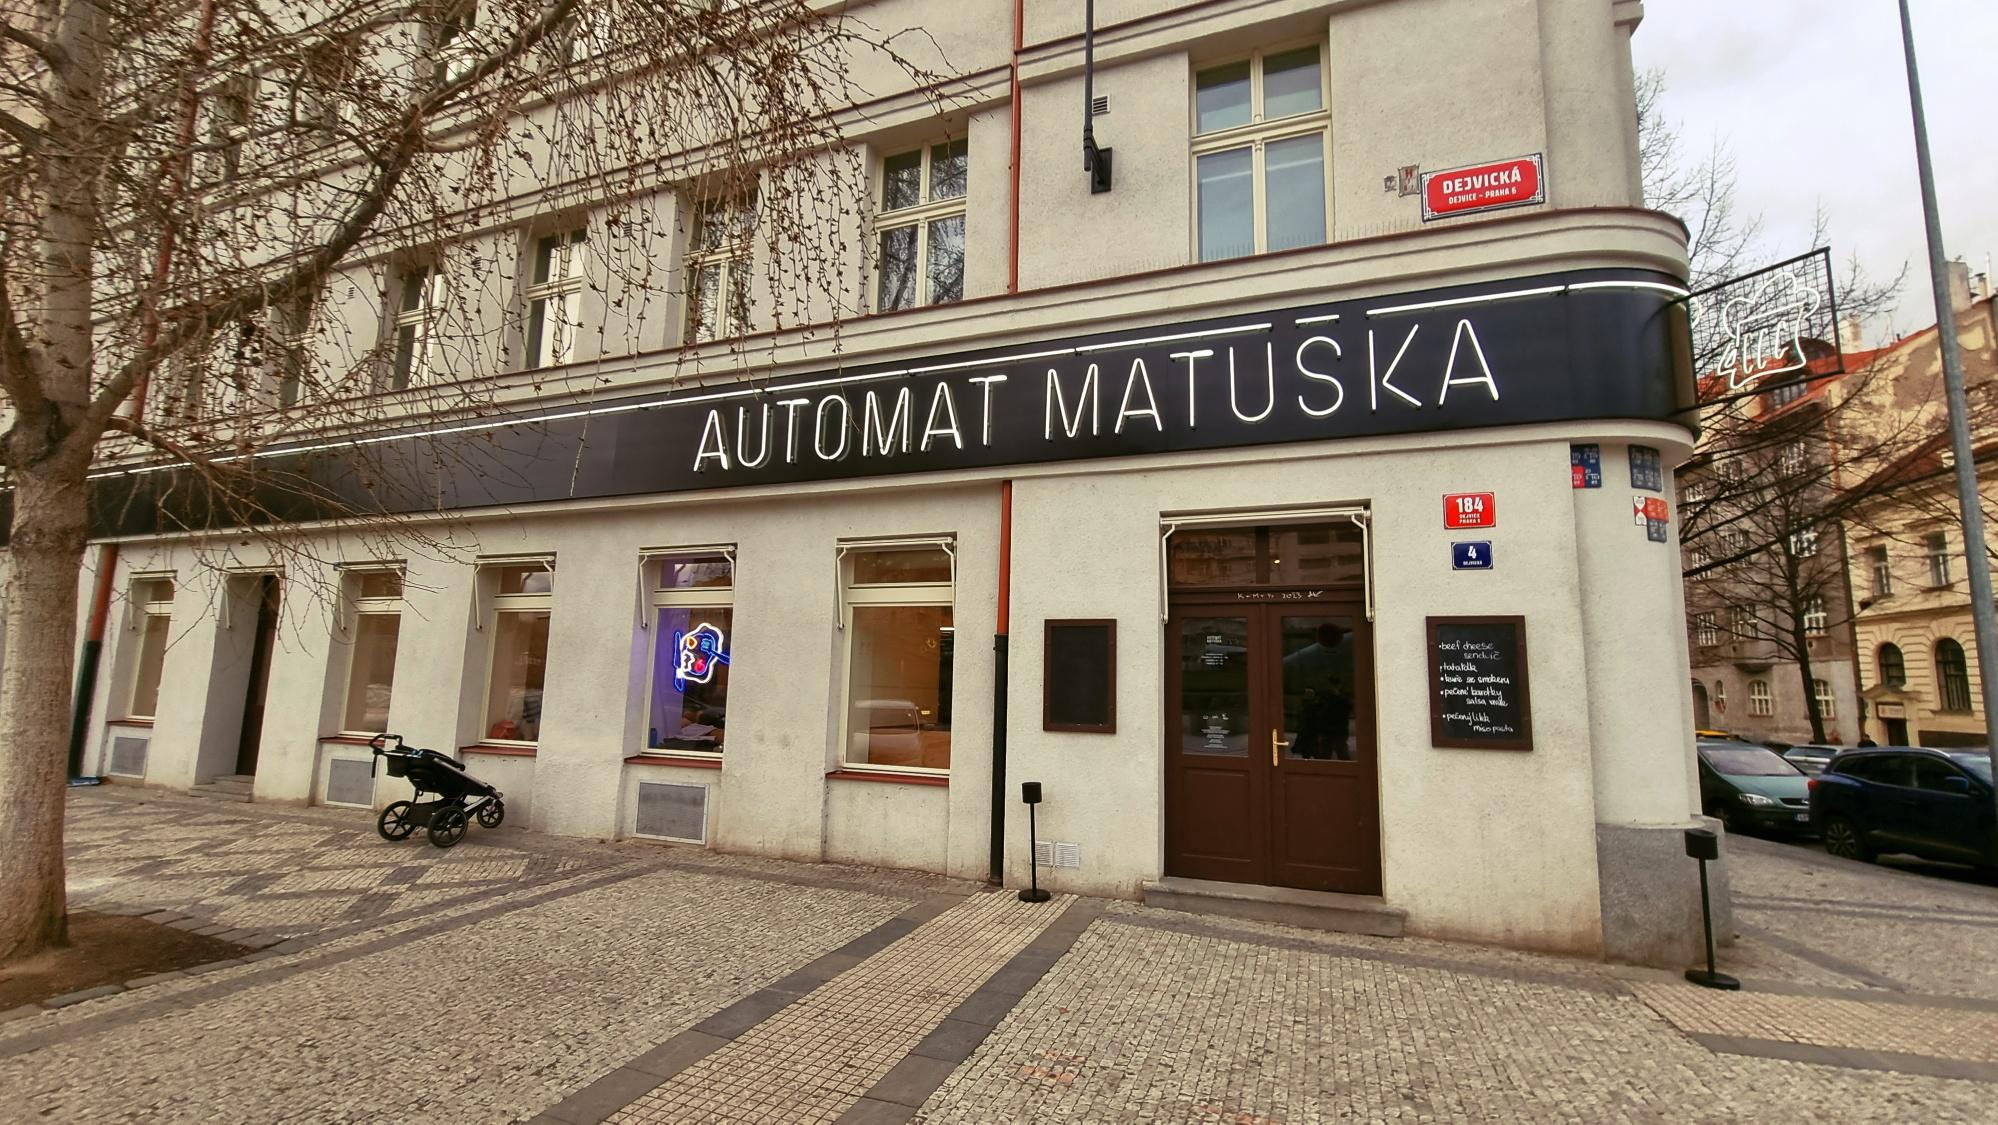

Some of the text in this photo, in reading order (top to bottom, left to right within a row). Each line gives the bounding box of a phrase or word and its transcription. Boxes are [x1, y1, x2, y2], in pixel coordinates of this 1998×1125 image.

[1442, 166, 1522, 194] DEJVICKÁ
[1448, 193, 1477, 205] DEJVICE
[1485, 188, 1510, 199] PRAHA
[1511, 186, 1517, 195] 6
[693, 375, 1008, 472] AUTOMAT
[1455, 496, 1484, 513] 184
[1467, 545, 1477, 559] 4
[1441, 640, 1460, 650] beef
